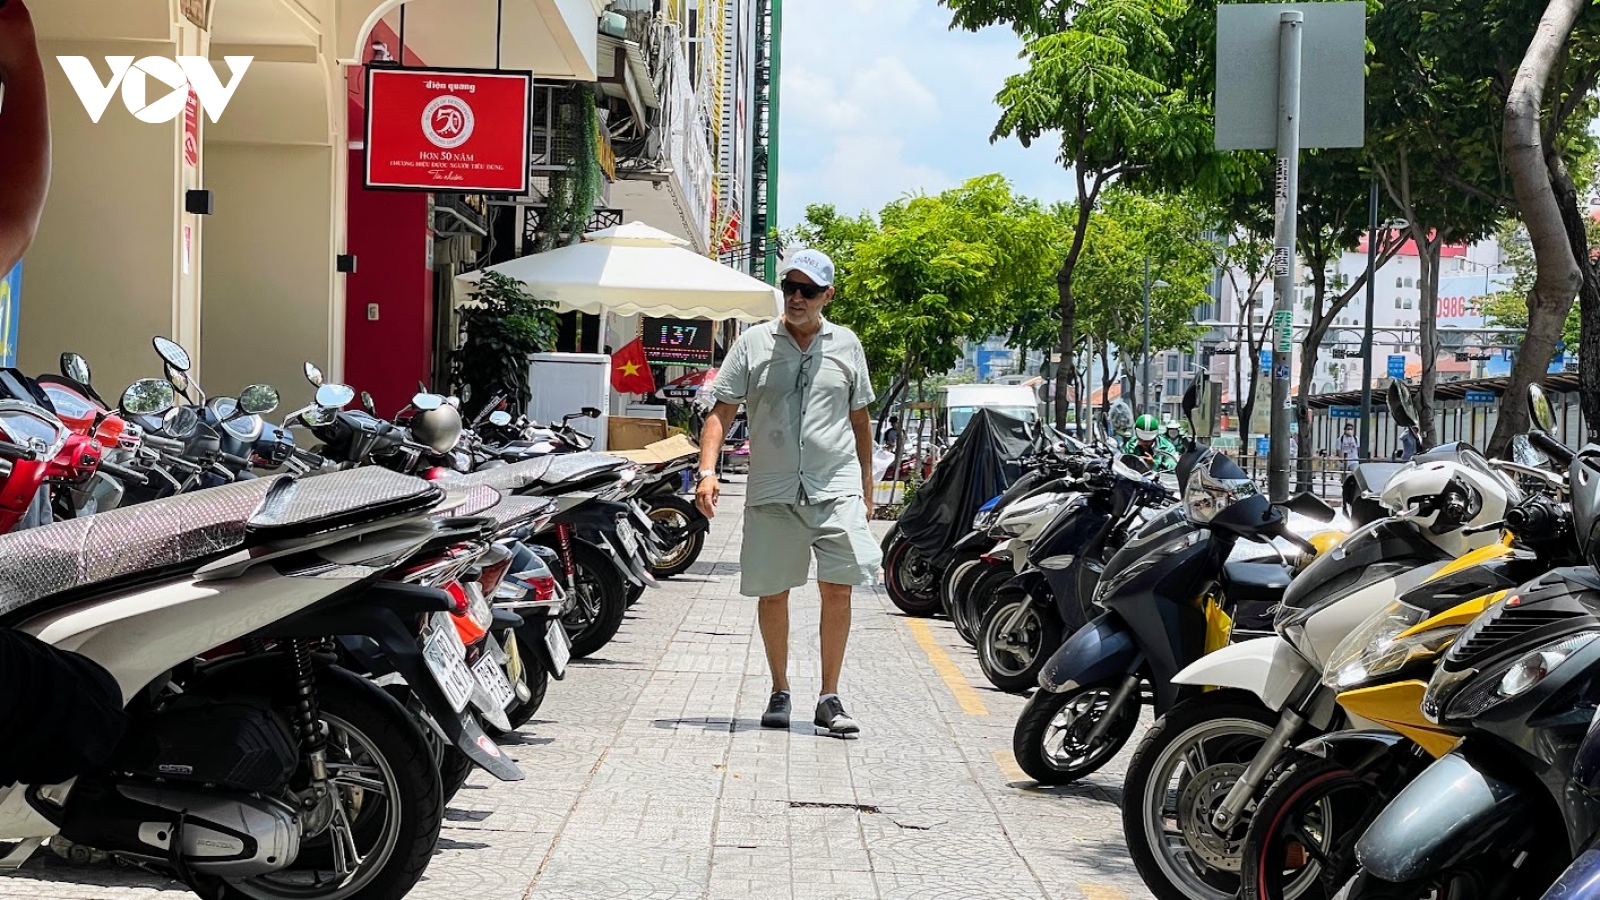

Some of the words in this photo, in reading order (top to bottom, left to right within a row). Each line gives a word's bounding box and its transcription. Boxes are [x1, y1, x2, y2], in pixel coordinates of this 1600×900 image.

[448, 83, 476, 94] quang
[440, 151, 453, 162] 50
[660, 325, 698, 346] 137
[197, 839, 236, 850] HONDA
